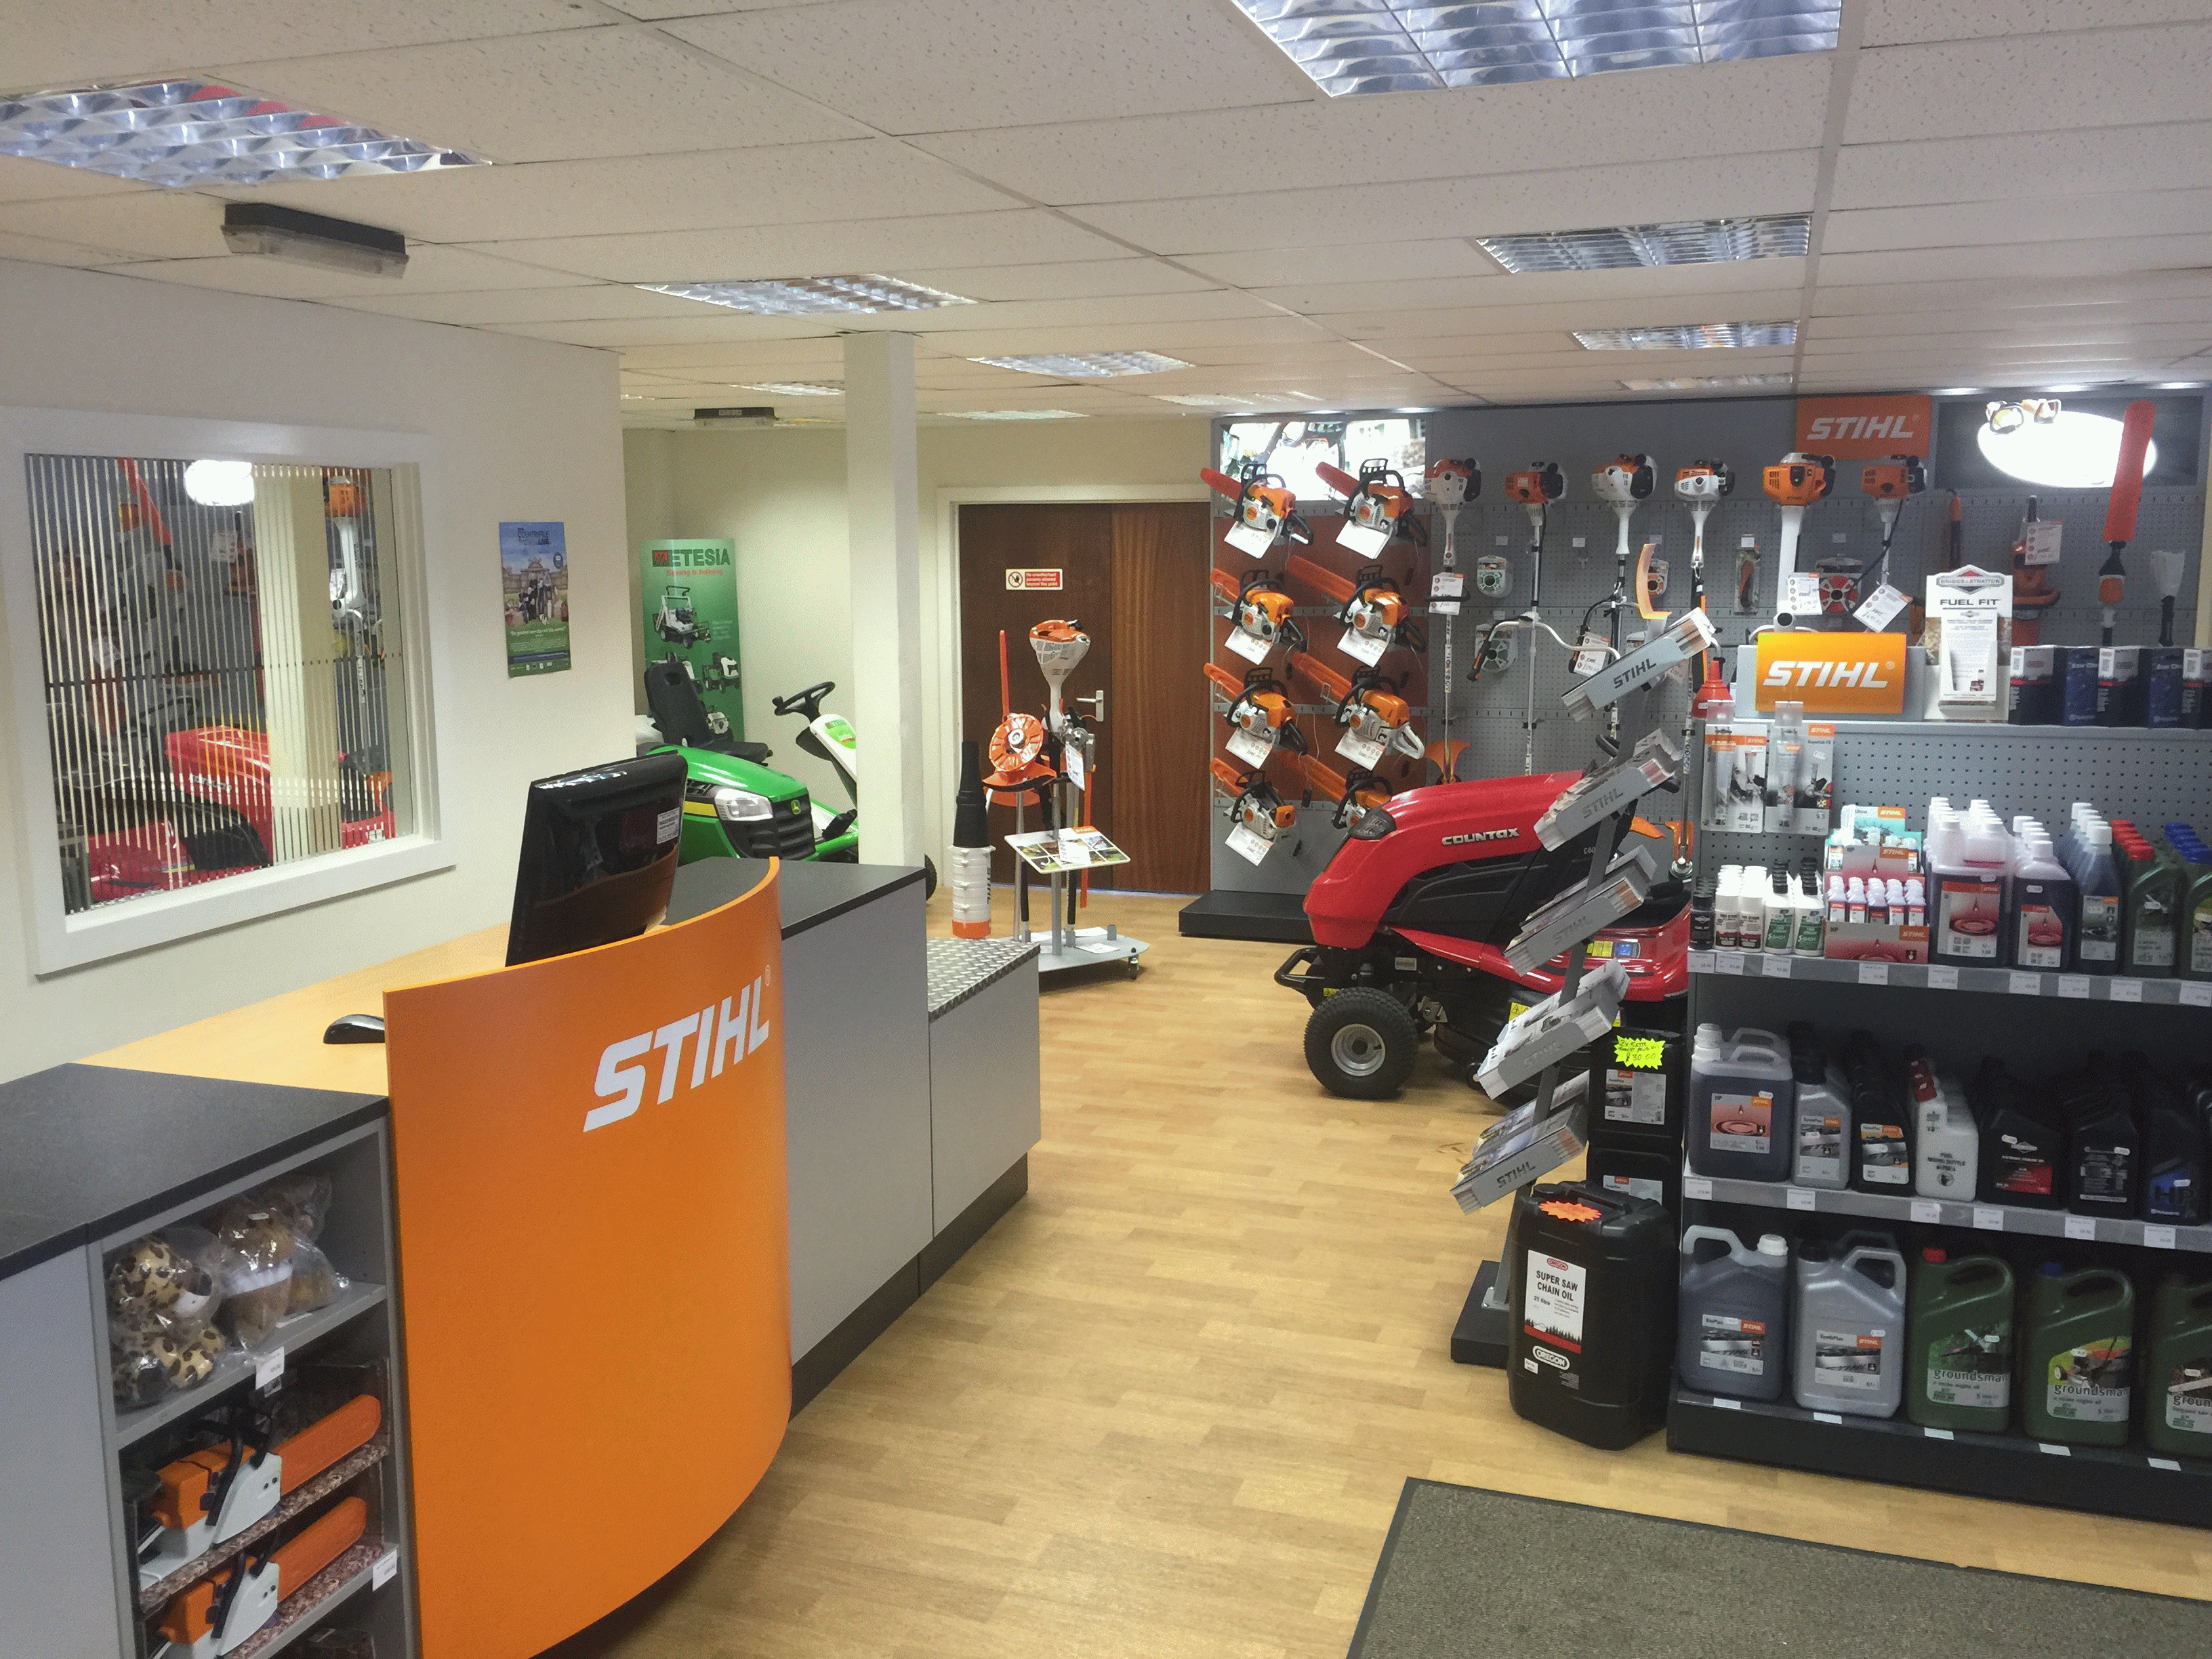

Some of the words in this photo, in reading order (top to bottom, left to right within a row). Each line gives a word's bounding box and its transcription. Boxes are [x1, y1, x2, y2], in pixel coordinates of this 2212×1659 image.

[1806, 415, 1914, 440] STIHL
[668, 548, 731, 567] ETESIA
[1613, 659, 1657, 689] STIHL
[1763, 660, 1888, 688] STIHL
[1582, 787, 1624, 819] STIHL
[1551, 916, 1593, 945] STIHL
[1902, 930, 1926, 938] STIHL
[583, 976, 769, 1132] STIHL
[1496, 1161, 1537, 1189] STIHL
[1536, 1270, 1560, 1286] SUPER
[1561, 1279, 1578, 1292] SAW
[1537, 1282, 1560, 1296] CHAIN
[1561, 1290, 1574, 1302] OIL
[1536, 1349, 1566, 1367] OREGON
[1933, 1370, 2007, 1382] groundsman
[2173, 1396, 2212, 1407] groun
